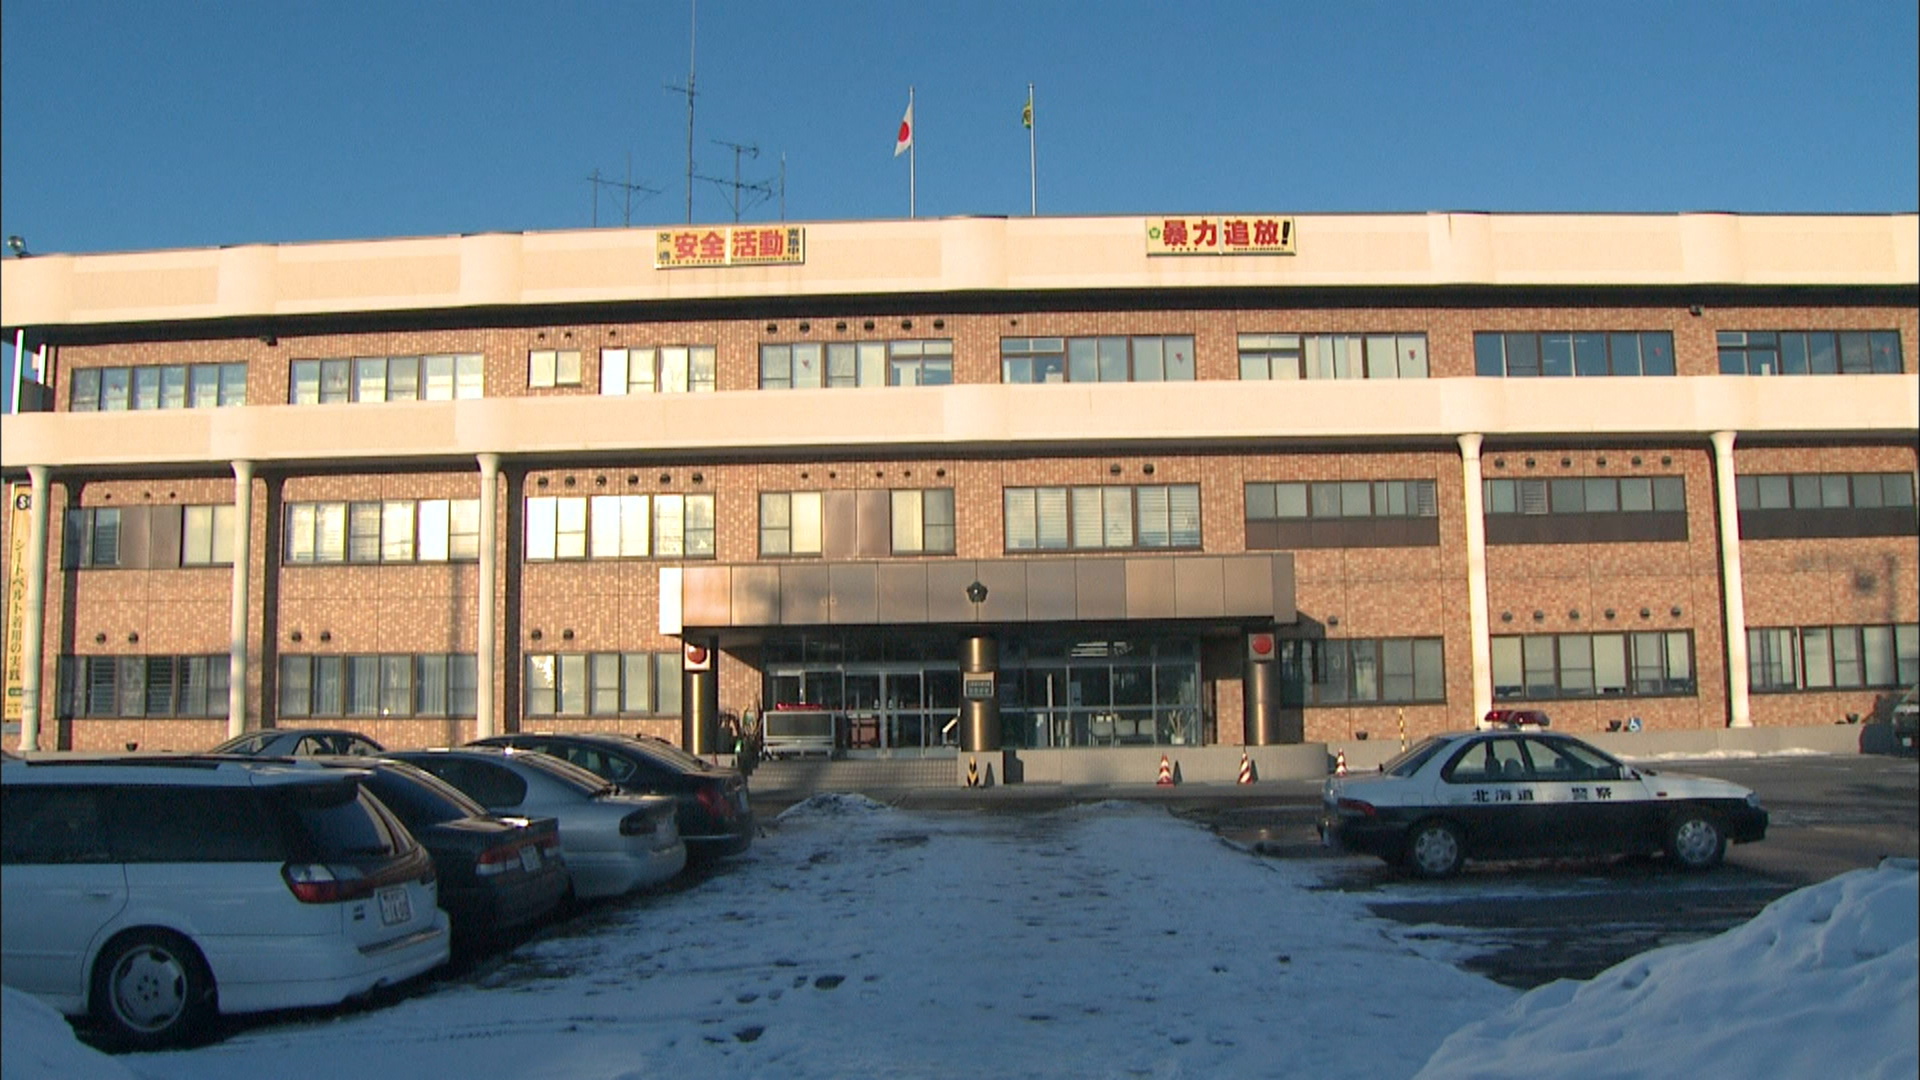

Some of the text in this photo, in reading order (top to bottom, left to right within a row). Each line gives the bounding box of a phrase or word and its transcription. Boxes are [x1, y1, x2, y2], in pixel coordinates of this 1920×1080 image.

[1472, 787, 1611, 802] 北海道 警察
